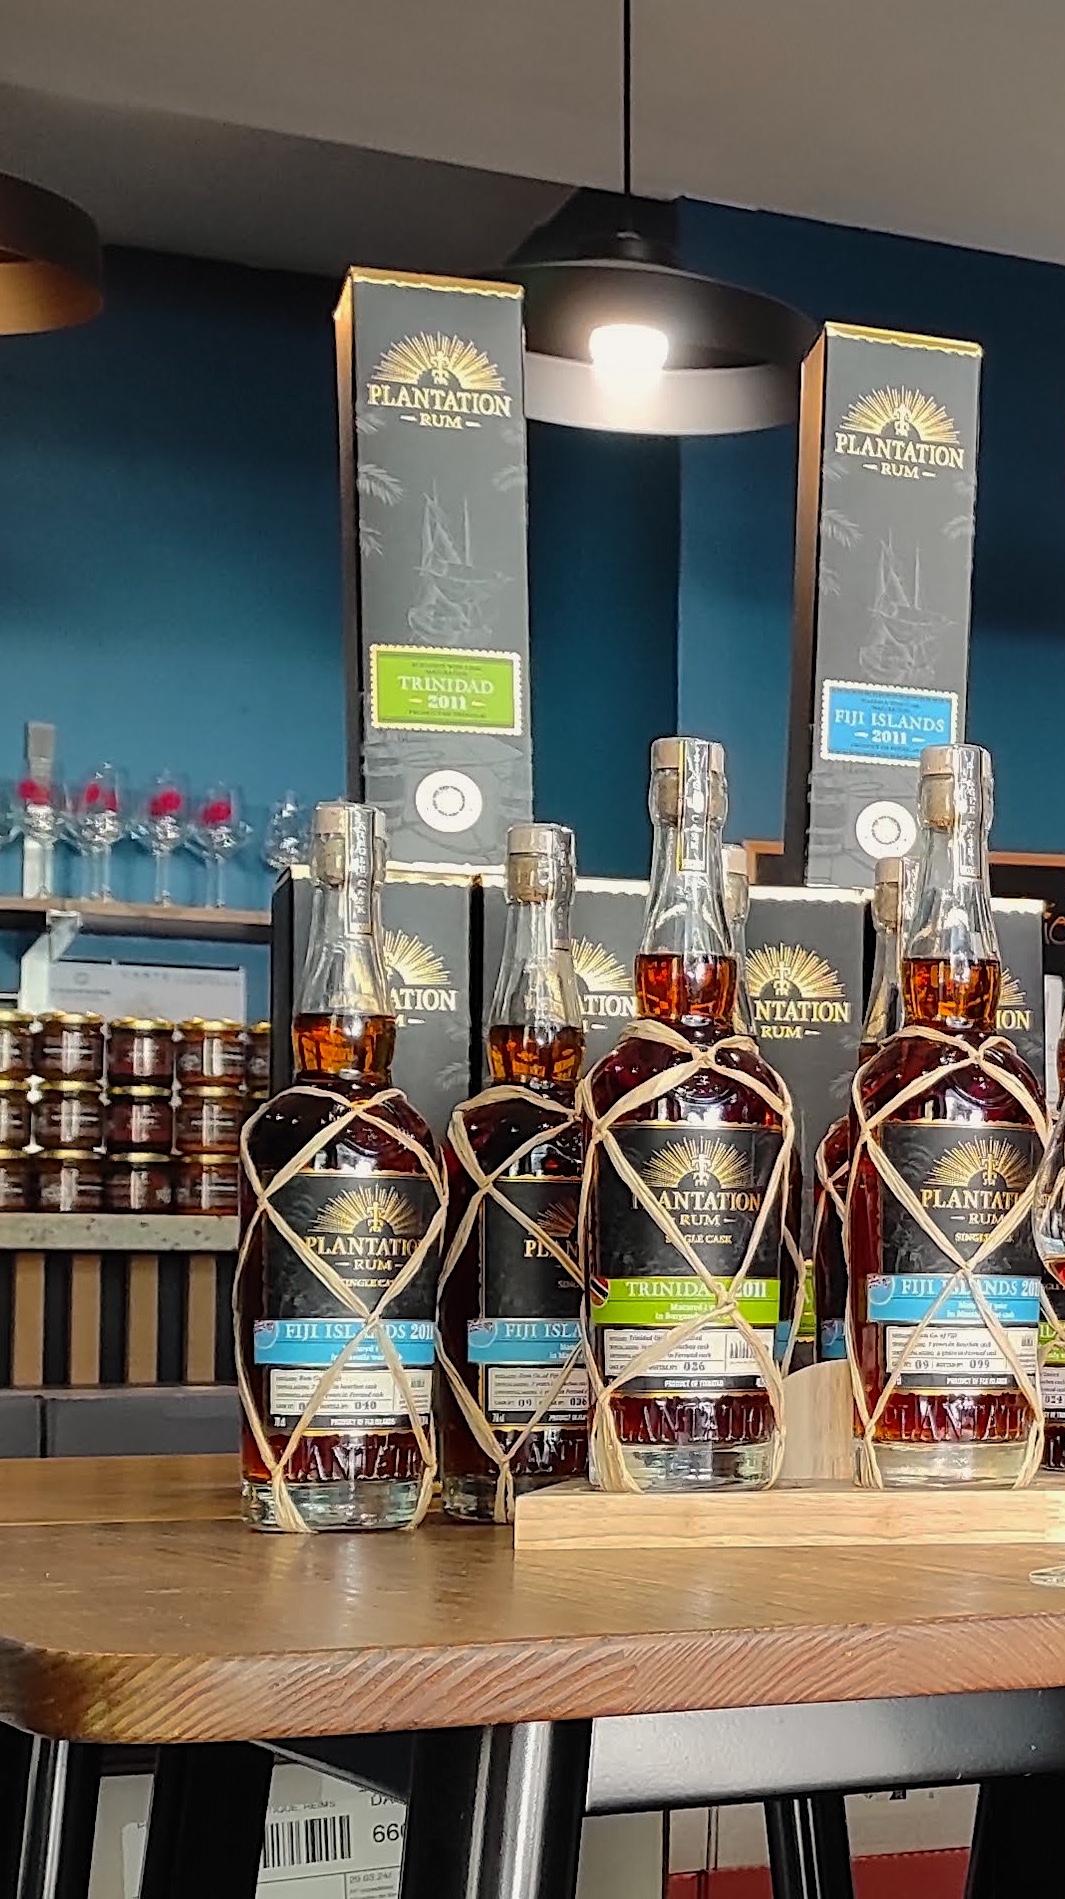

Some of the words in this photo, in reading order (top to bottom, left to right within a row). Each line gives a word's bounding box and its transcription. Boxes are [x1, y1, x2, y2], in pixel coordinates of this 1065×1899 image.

[366, 382, 513, 418] PLANTATION
[419, 412, 463, 430] RUM
[834, 431, 965, 470] PLANTATION
[880, 461, 920, 480] RUM
[397, 675, 494, 695] TRINIDAD
[427, 694, 467, 710] 2011
[834, 709, 865, 727] FIJI
[871, 713, 945, 733] ISLANDS
[871, 729, 908, 745] 2011
[390, 987, 459, 1012] ATION
[578, 993, 638, 1018] ATION
[754, 999, 850, 1024] NTATION
[760, 1025, 802, 1040] RUM
[632, 1190, 762, 1212] ANTATION
[920, 1188, 1021, 1210] PLANTATI
[679, 1214, 721, 1226] RUM
[307, 1235, 422, 1257] PLANTATIO
[665, 1234, 704, 1245] SGLE
[353, 1259, 394, 1271] RUM
[625, 1281, 728, 1297] TRINIDA
[902, 1279, 935, 1299] FIJI
[285, 1323, 319, 1341] FIJI
[325, 1323, 407, 1341] ISLDS
[410, 1324, 435, 1341] 2011
[505, 1323, 537, 1340] FIJI
